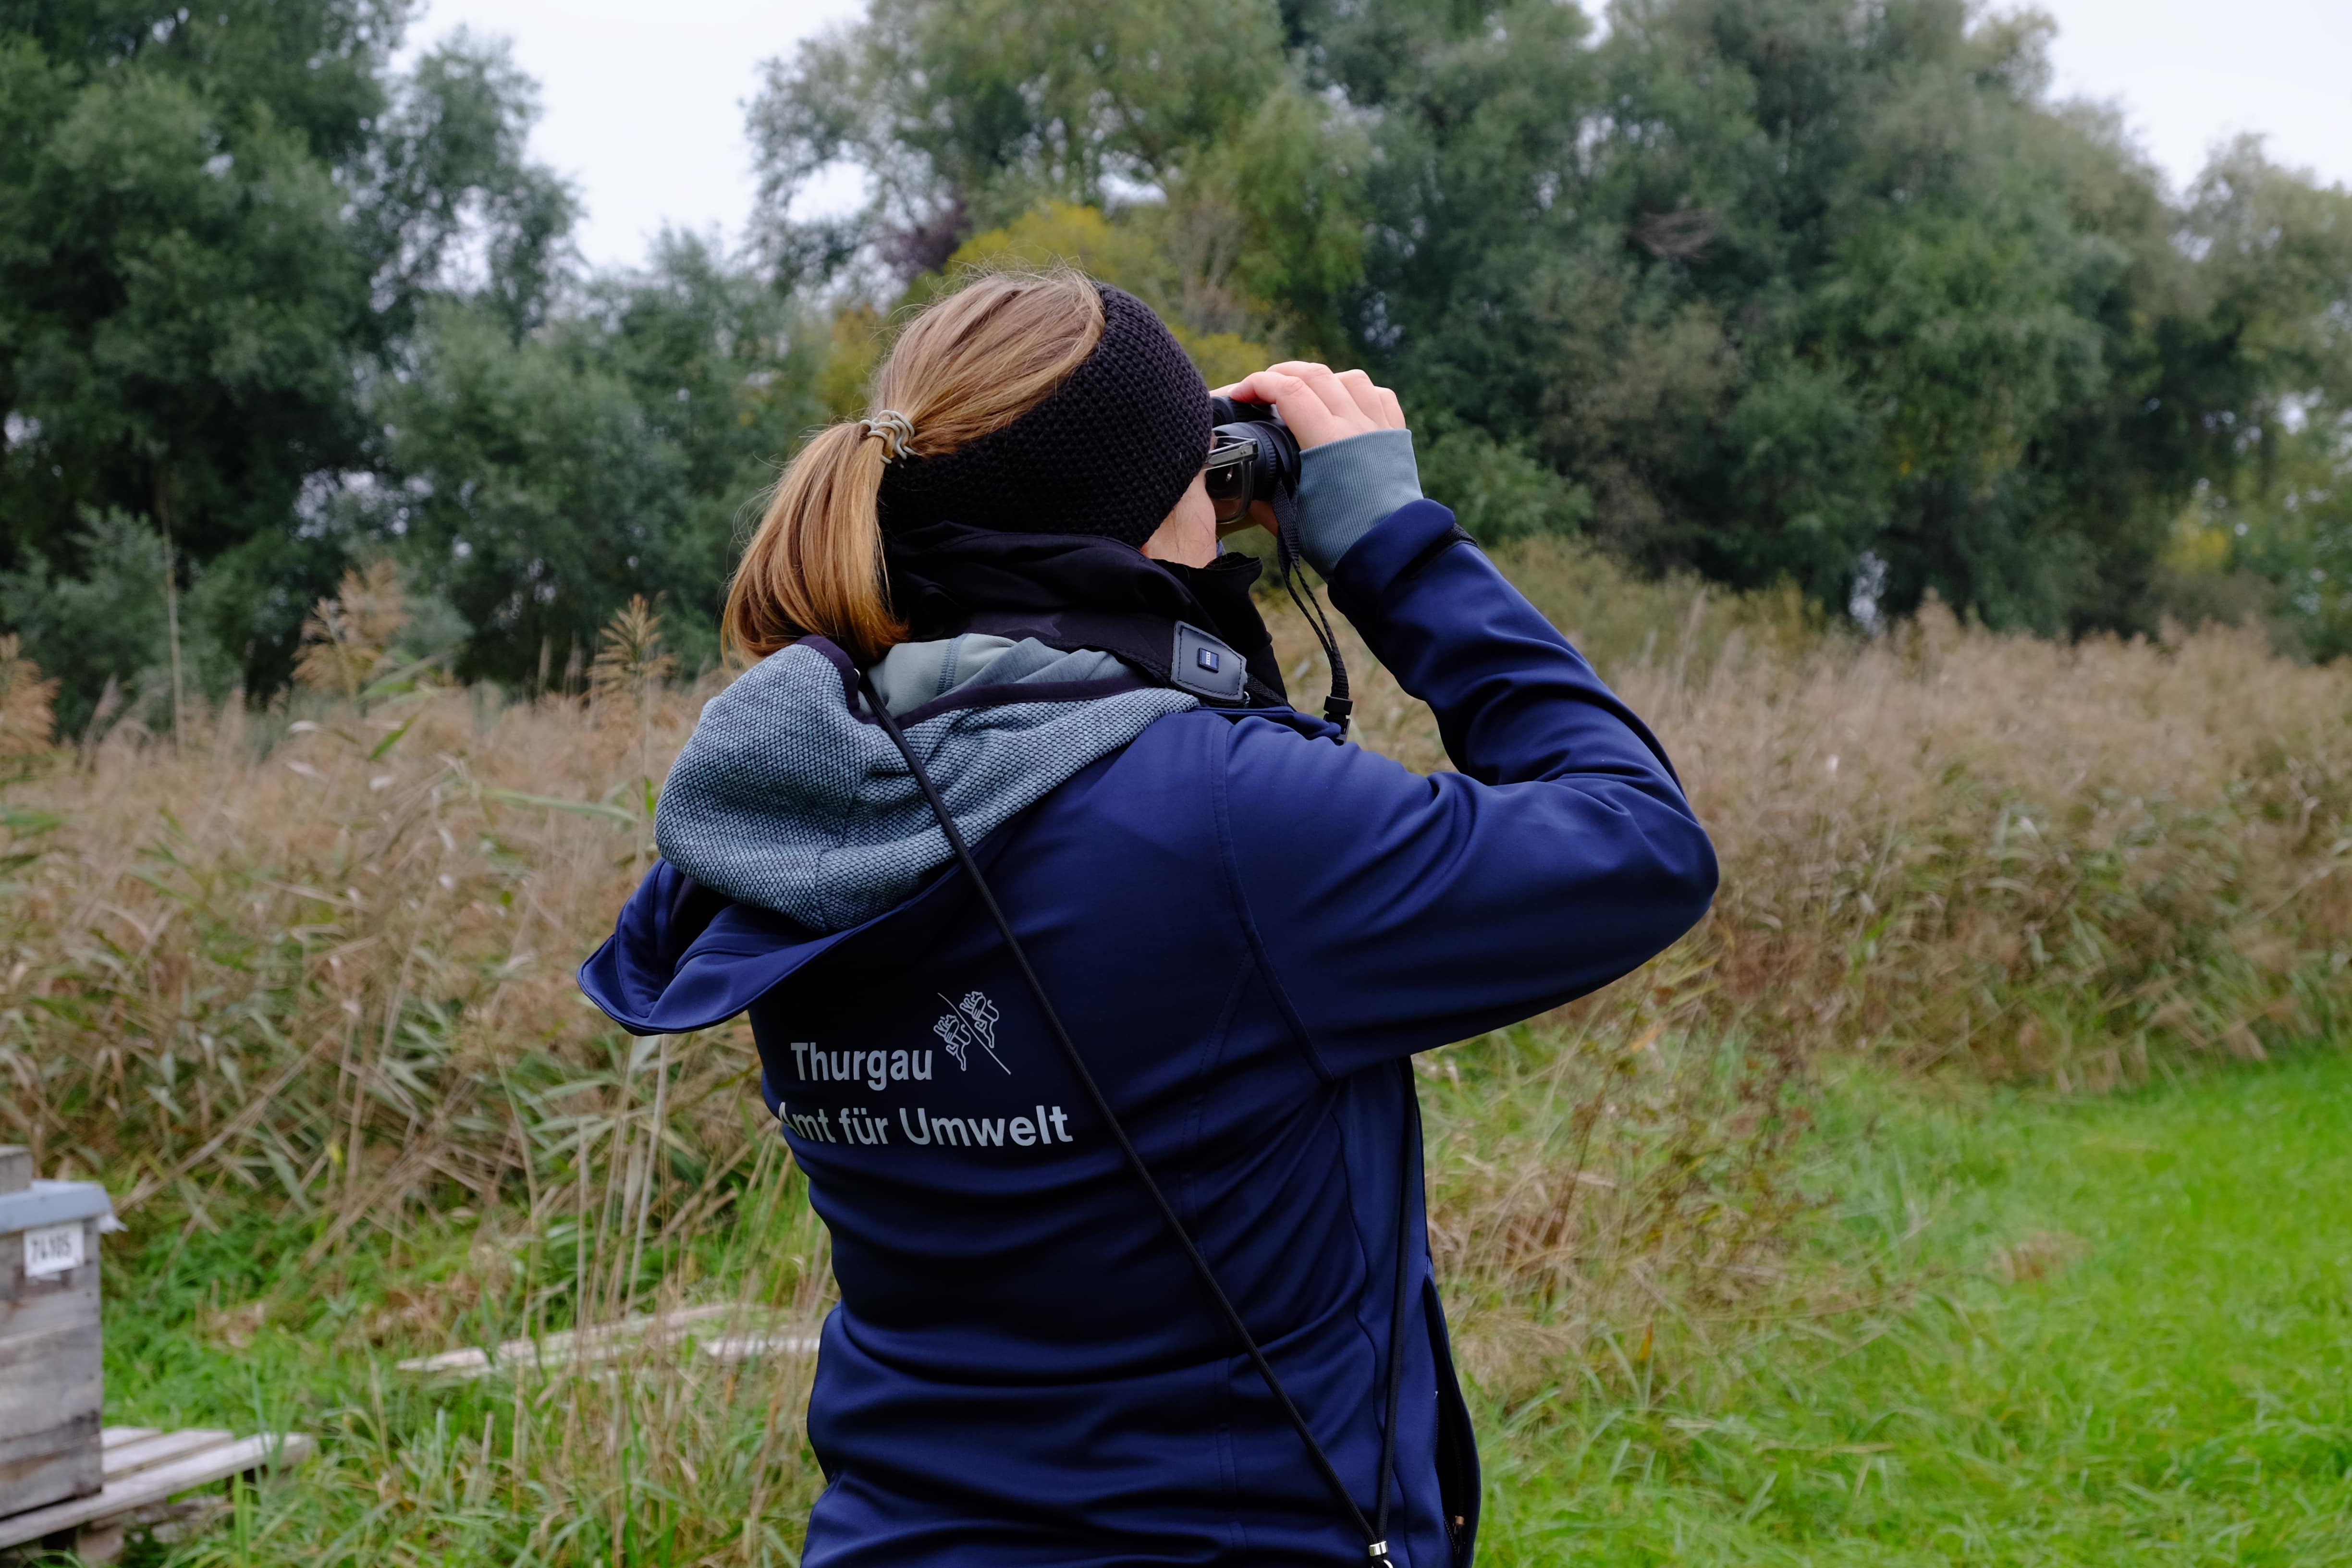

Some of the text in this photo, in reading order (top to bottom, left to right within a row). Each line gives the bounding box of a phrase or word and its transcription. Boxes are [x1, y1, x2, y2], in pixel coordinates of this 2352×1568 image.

[790, 1042, 932, 1091] Thurgau
[778, 1102, 1073, 1146] Amt für Umwelt
